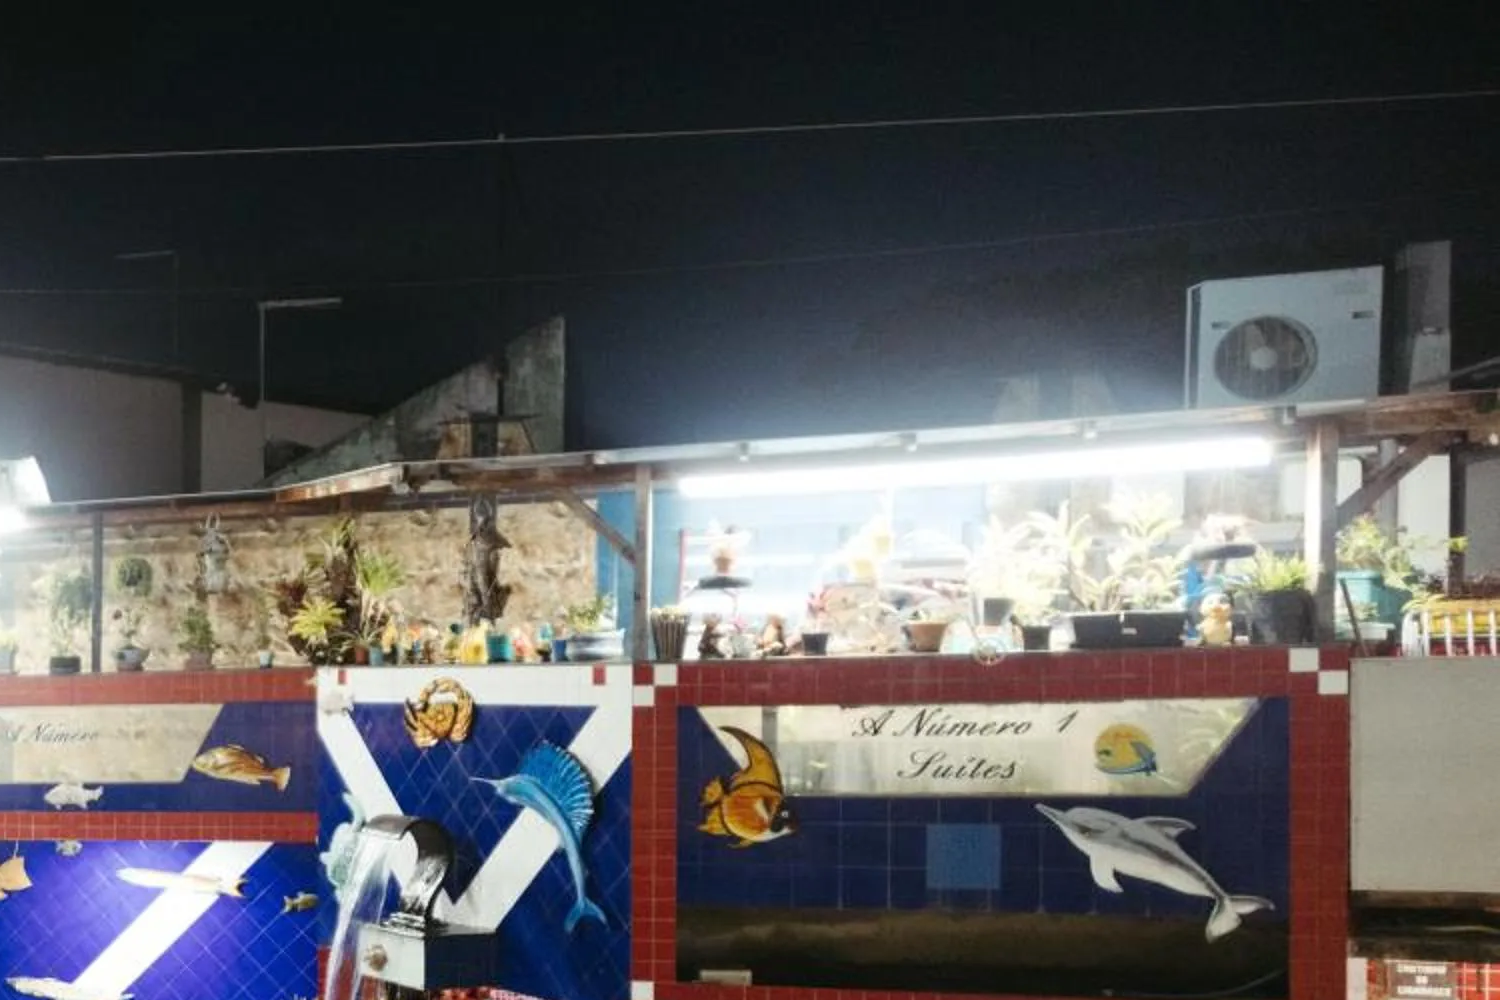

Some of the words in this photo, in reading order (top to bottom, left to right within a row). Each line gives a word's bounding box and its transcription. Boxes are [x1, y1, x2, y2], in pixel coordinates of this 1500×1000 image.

[852, 708, 895, 737] A
[892, 706, 1033, 737] Número
[1057, 709, 1080, 734] 1
